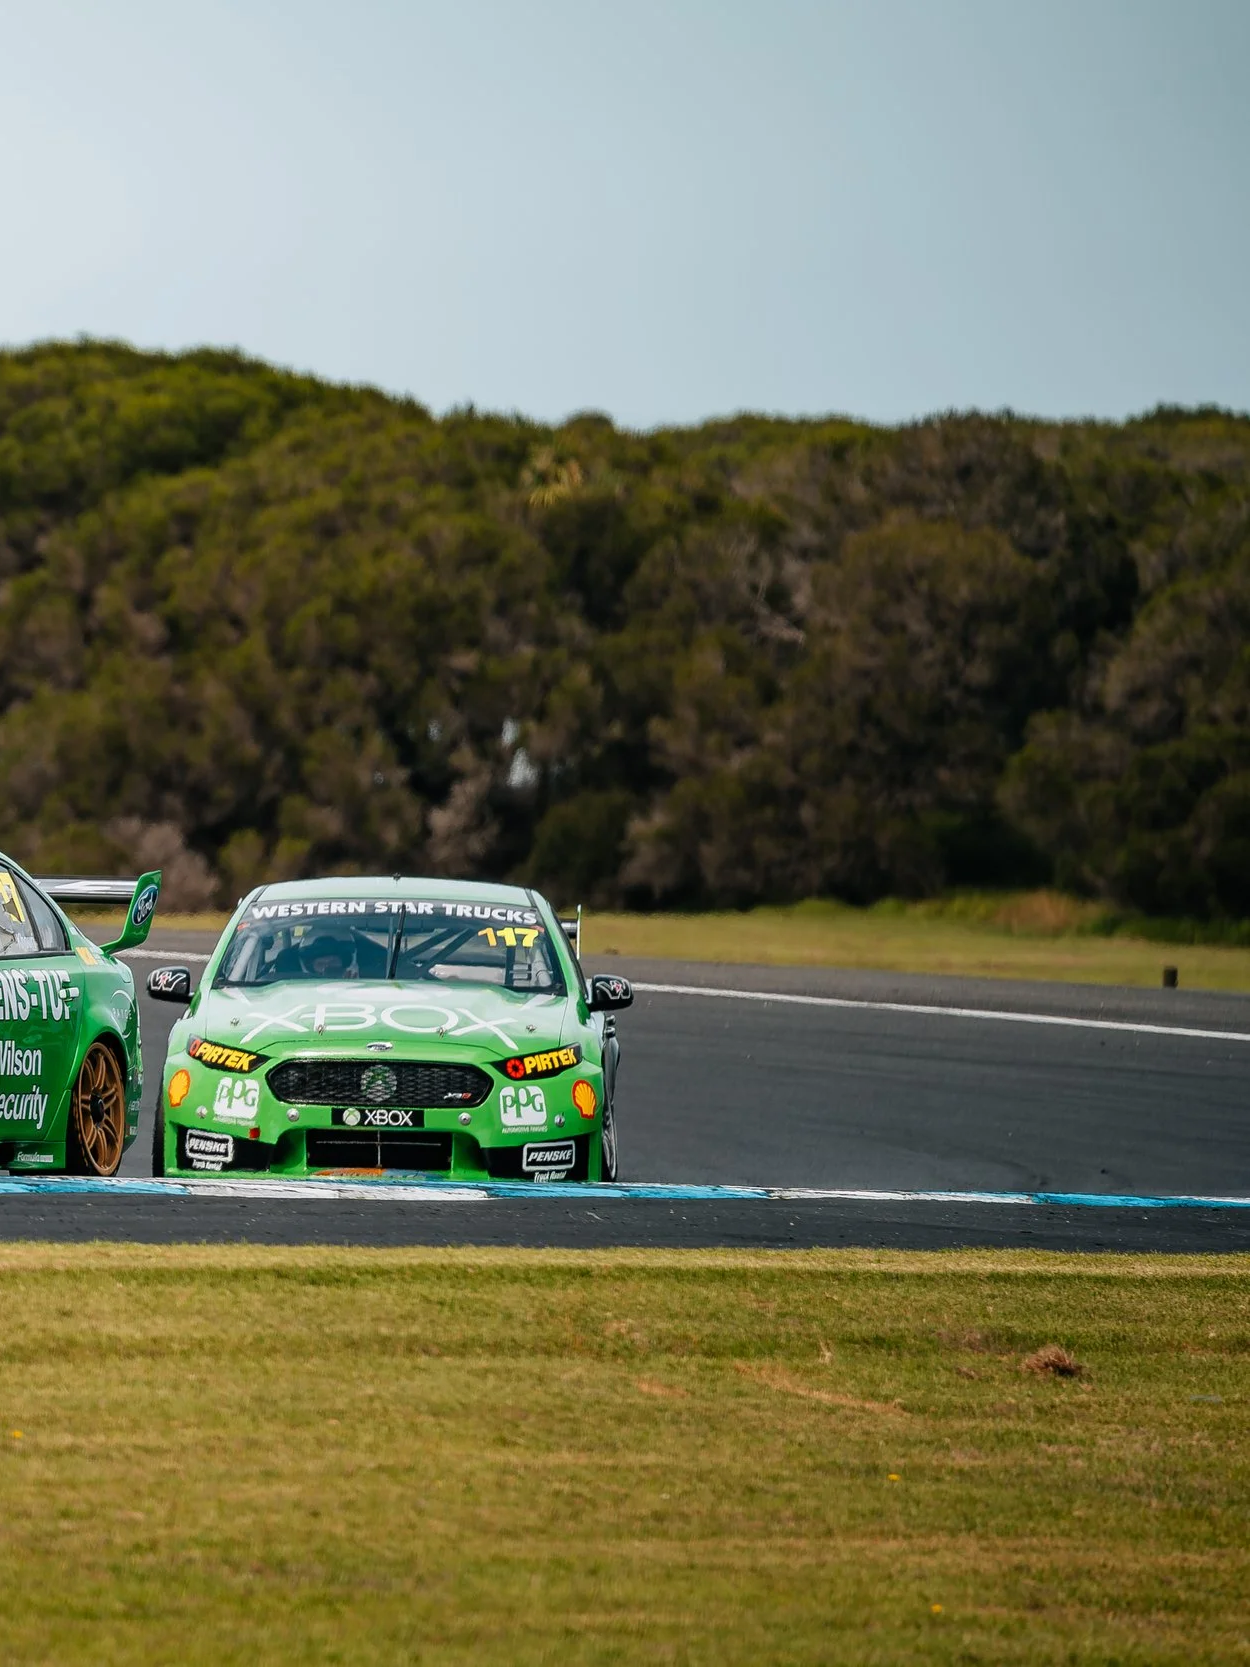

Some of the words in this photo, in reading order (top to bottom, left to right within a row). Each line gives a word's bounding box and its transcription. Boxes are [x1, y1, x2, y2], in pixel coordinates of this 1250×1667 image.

[136, 891, 154, 923] Ford
[251, 901, 366, 920] WESTERN
[374, 900, 434, 916] STAR
[445, 902, 537, 925] TRUCKS
[478, 927, 539, 948] 117
[239, 1003, 519, 1051] XBOX
[195, 1041, 257, 1072] PIRTEK
[523, 1048, 577, 1075] PIRTEK
[502, 1087, 544, 1118] PPG
[363, 1109, 414, 1127] XBOX
[527, 1150, 573, 1162] PENSKE
[534, 1172, 550, 1183] Truck
